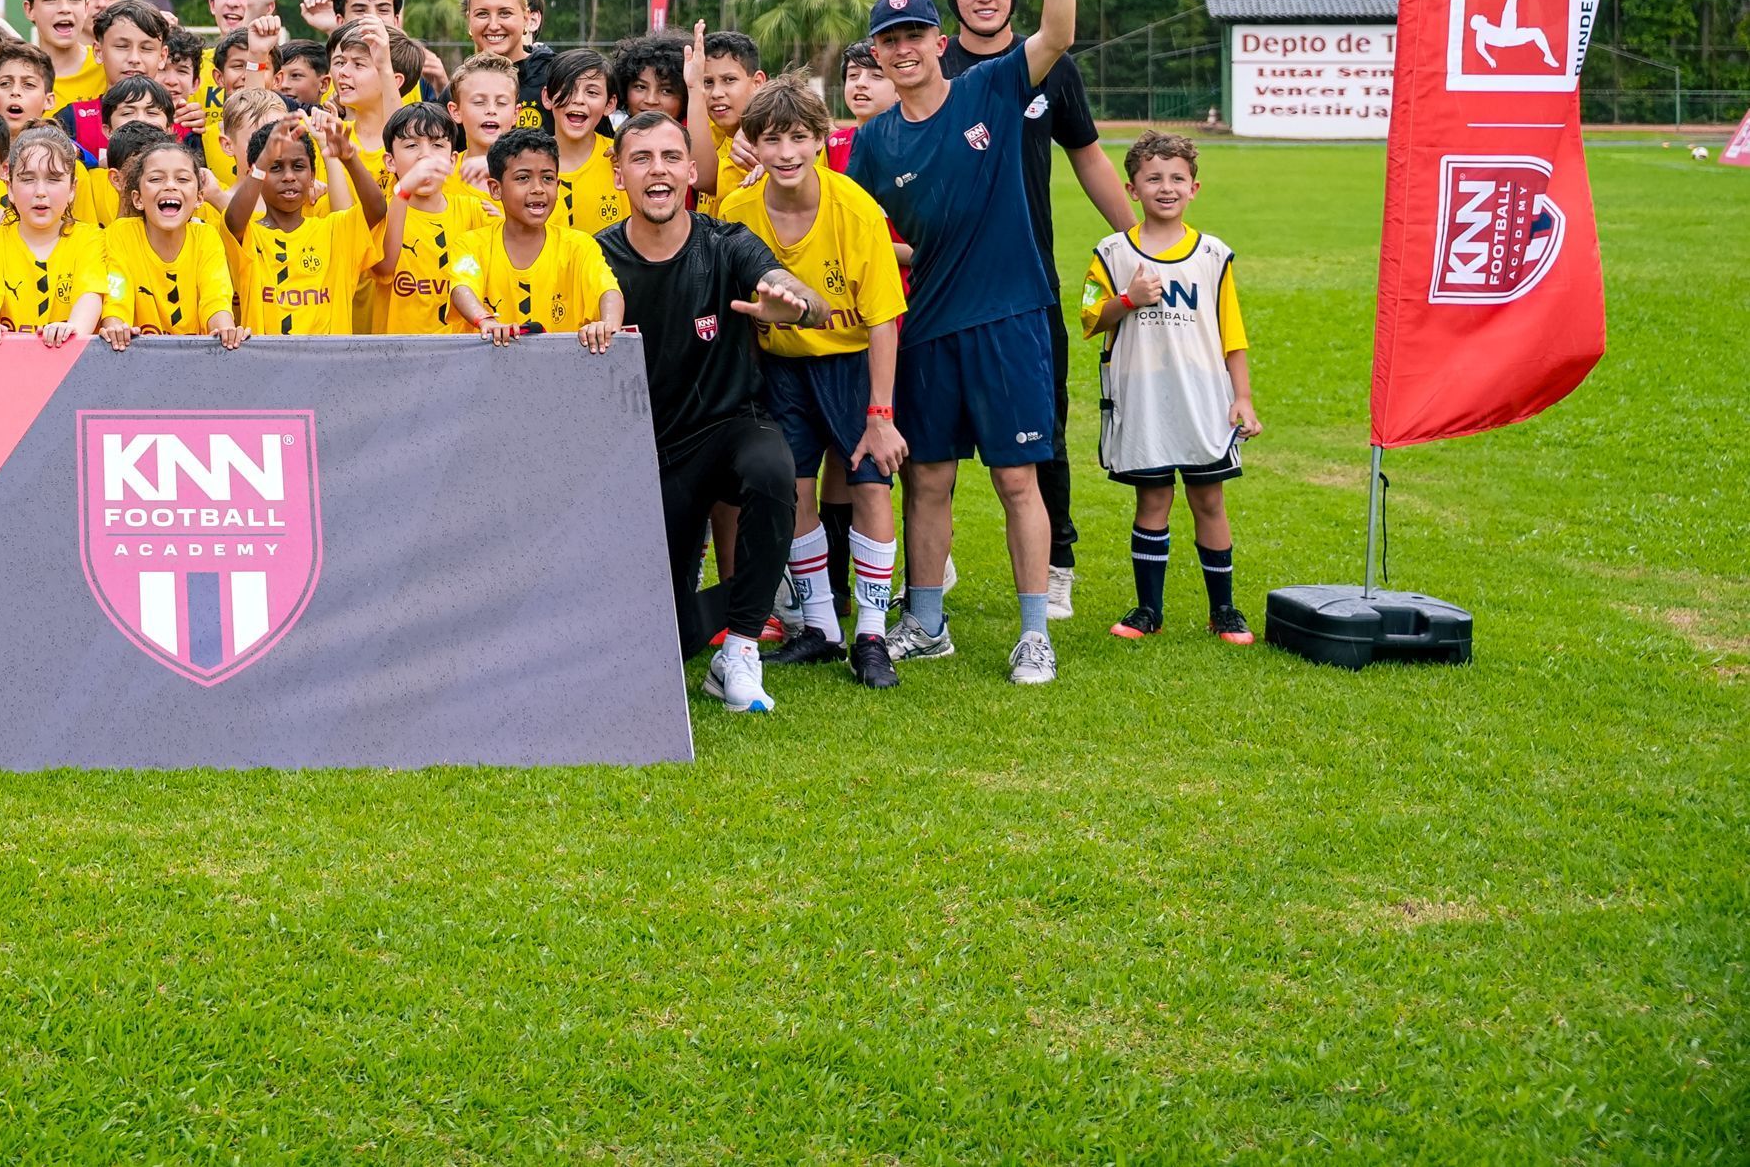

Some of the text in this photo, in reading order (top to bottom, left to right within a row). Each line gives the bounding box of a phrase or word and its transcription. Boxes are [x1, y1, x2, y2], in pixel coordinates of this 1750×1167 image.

[1241, 34, 1326, 57] Depto
[1336, 33, 1371, 53] de
[1257, 67, 1324, 78] Lutar
[1255, 86, 1347, 97] Vencer
[1249, 103, 1352, 116] Desistir
[520, 111, 539, 126] BVB
[601, 204, 618, 217] BVB
[1445, 181, 1496, 284] KNN
[1489, 182, 1511, 284] FOOTBALL
[1509, 186, 1528, 280] ACADEMY
[826, 270, 845, 288] BVB
[698, 318, 714, 328] KNN
[103, 434, 284, 501] KNN
[105, 509, 286, 527] FOOTBALL
[114, 544, 278, 556] ACADEMY
